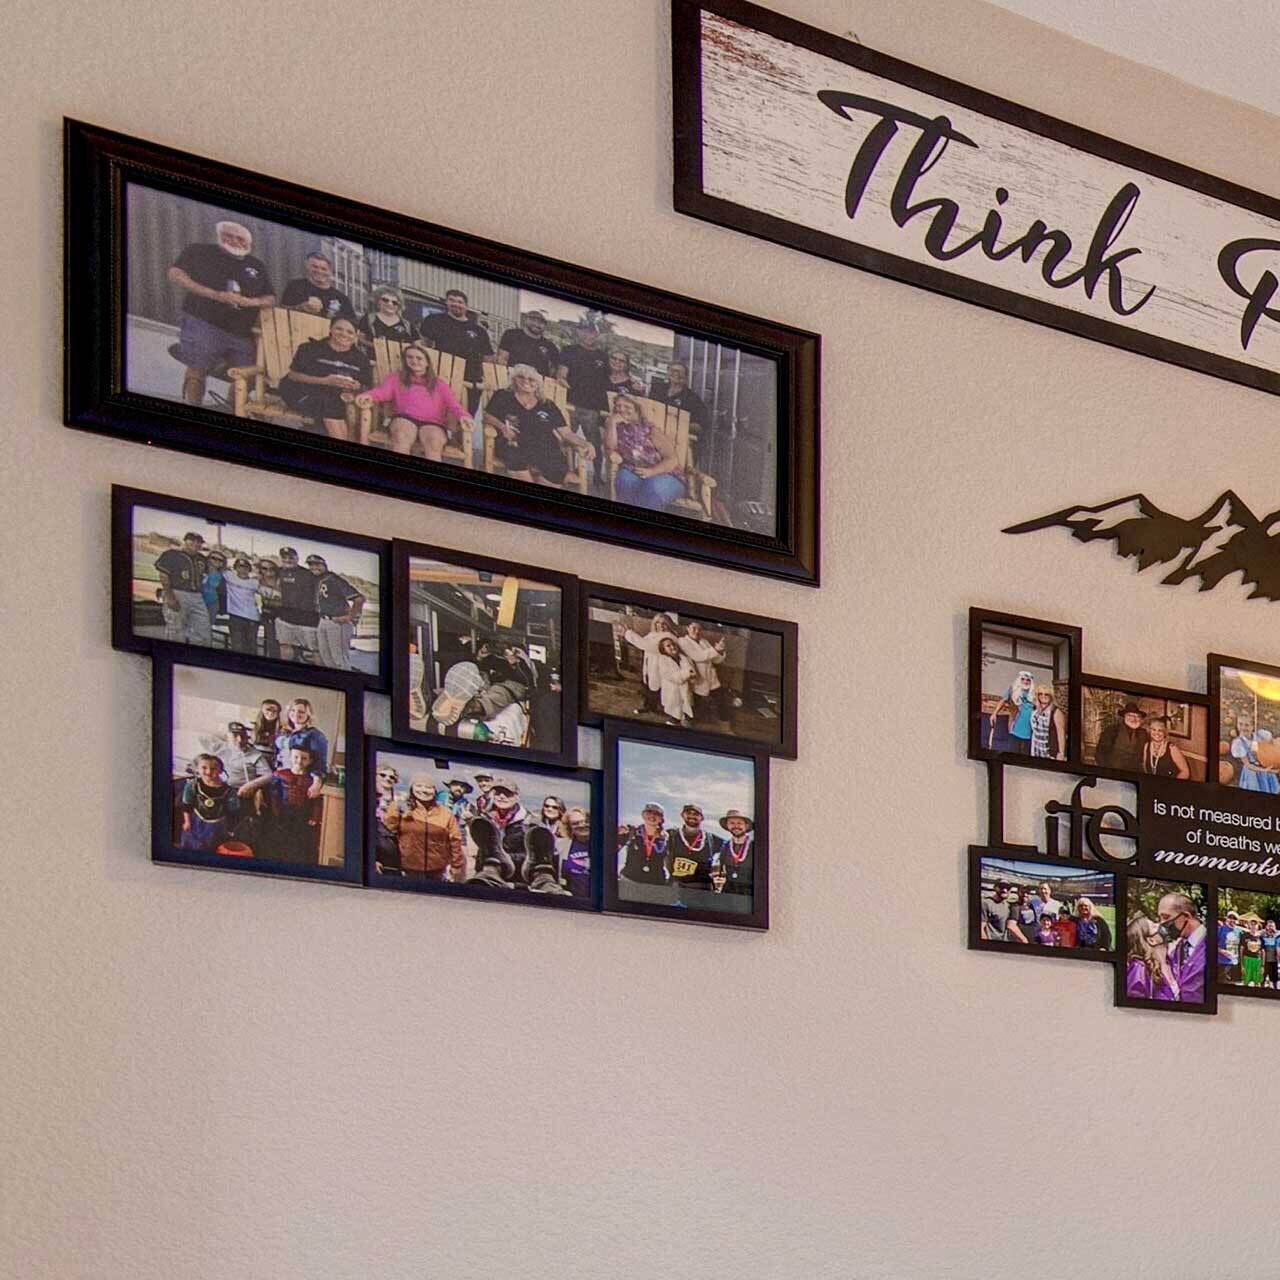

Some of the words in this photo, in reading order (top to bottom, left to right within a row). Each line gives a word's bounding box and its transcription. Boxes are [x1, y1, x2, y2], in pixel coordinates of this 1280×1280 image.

[816, 88, 1157, 316] Think
[986, 757, 1139, 868] Life
[1153, 799, 1167, 815] is
[1170, 804, 1195, 819] not
[1199, 808, 1272, 830] measured
[1186, 828, 1202, 844] of
[1206, 829, 1261, 852] breaths
